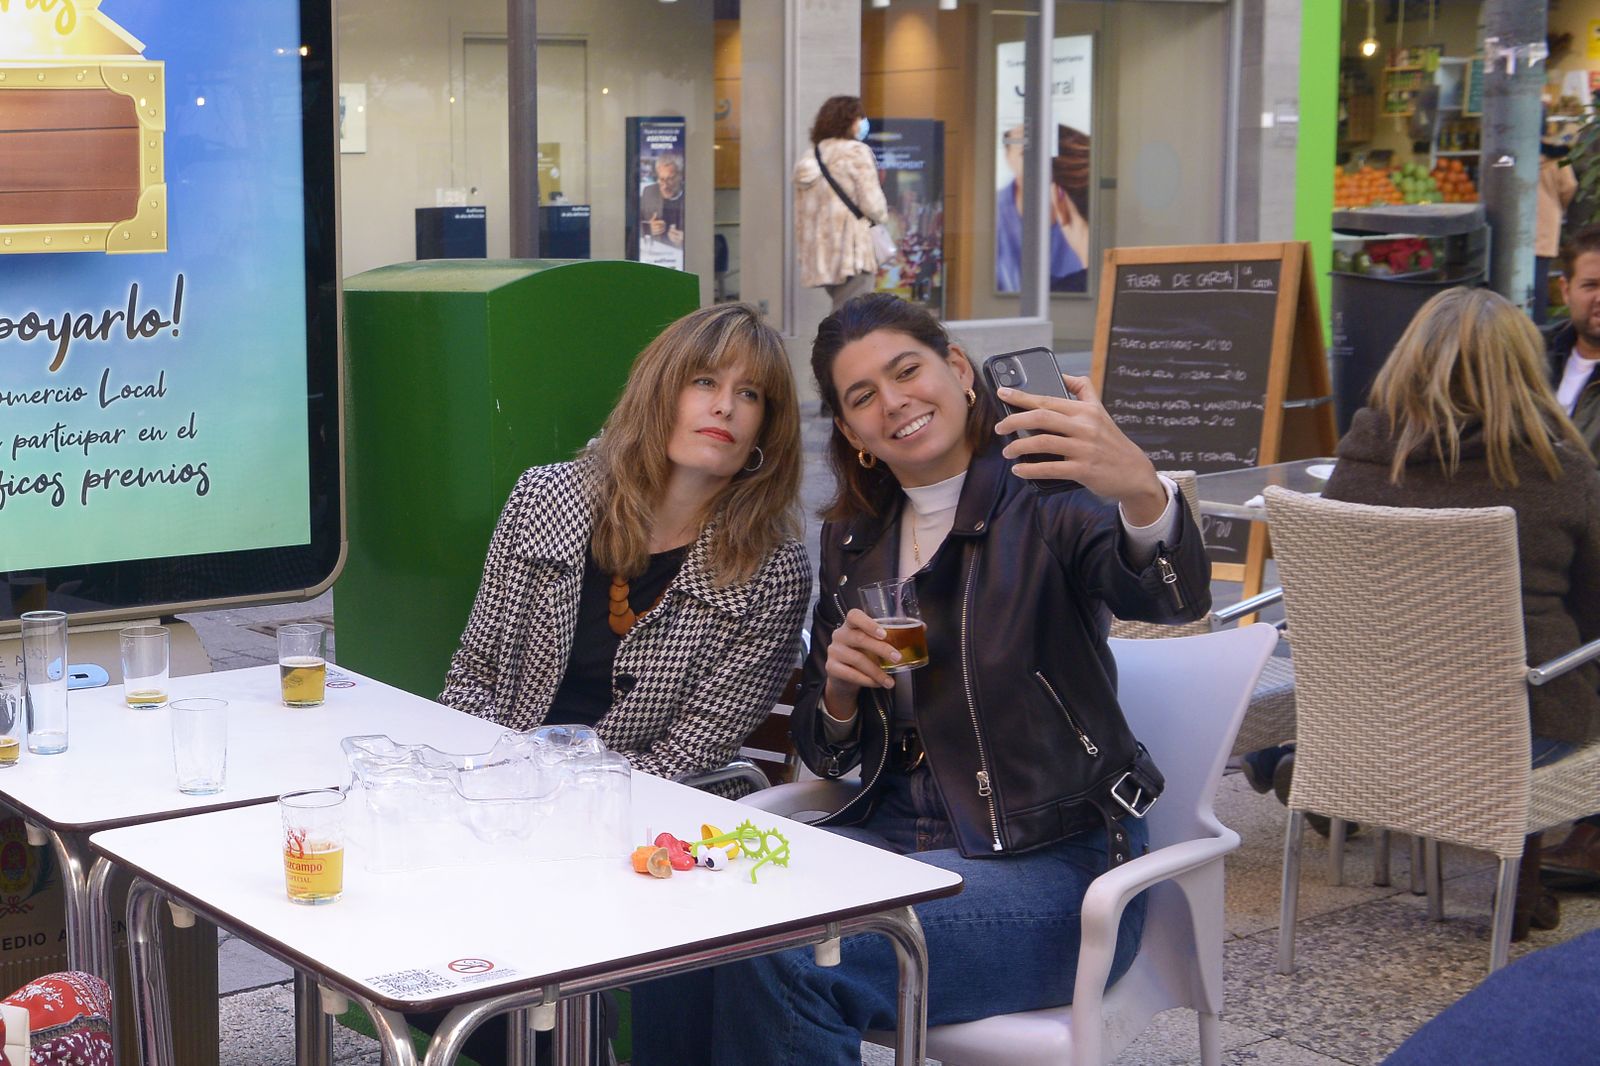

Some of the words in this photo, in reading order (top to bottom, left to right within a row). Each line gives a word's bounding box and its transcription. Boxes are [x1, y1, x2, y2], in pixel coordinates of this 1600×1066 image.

[1126, 274, 1161, 288] FUERA
[1172, 273, 1192, 288] DE
[99, 367, 167, 409] Local
[12, 422, 126, 460] participar
[138, 426, 168, 442] en
[177, 412, 198, 441] el
[81, 461, 210, 506] premios
[2, 932, 47, 951] EDIO
